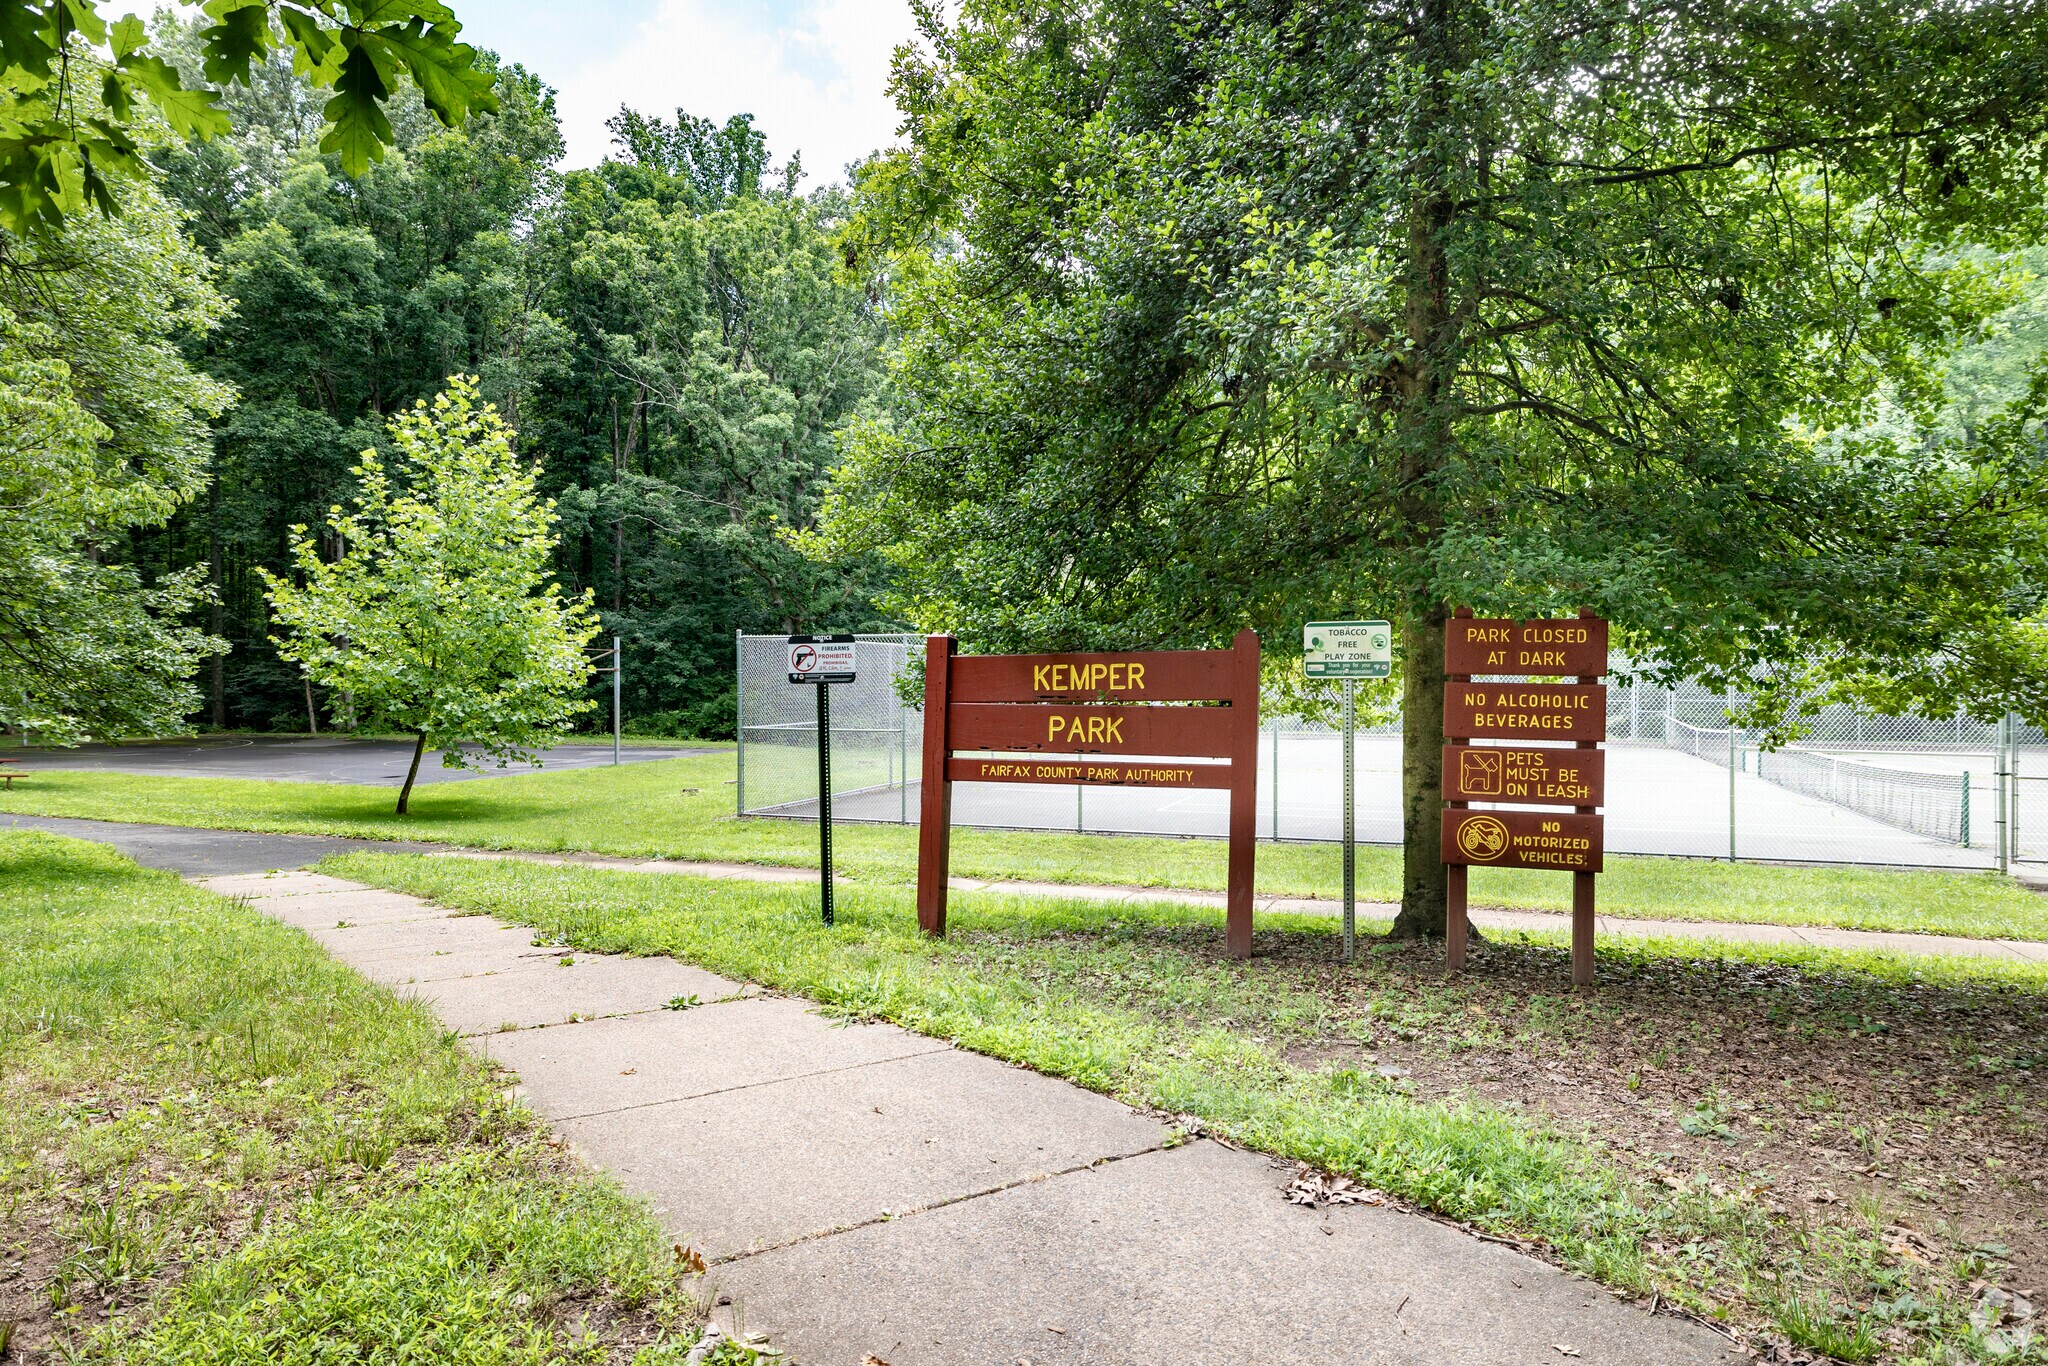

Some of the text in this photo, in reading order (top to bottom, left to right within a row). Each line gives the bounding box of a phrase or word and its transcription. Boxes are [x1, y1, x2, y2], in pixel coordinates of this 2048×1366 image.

[1468, 629, 1586, 643] PARK CLOSED
[1487, 651, 1565, 665] AT DARK
[1034, 663, 1144, 692] KEMPER
[1465, 693, 1588, 708] NO ALCOHOLIC
[1475, 713, 1572, 729] BEVERAGES
[1049, 716, 1123, 743] PARK
[1507, 752, 1543, 766] PETS
[982, 765, 1193, 782] FAIRFAX COUNTY PARK AUTHORITY
[1507, 768, 1578, 782] MUST BE
[1507, 783, 1589, 798] ON LEASH
[1542, 822, 1560, 832] NO
[1514, 836, 1589, 849] MOTORIZED
